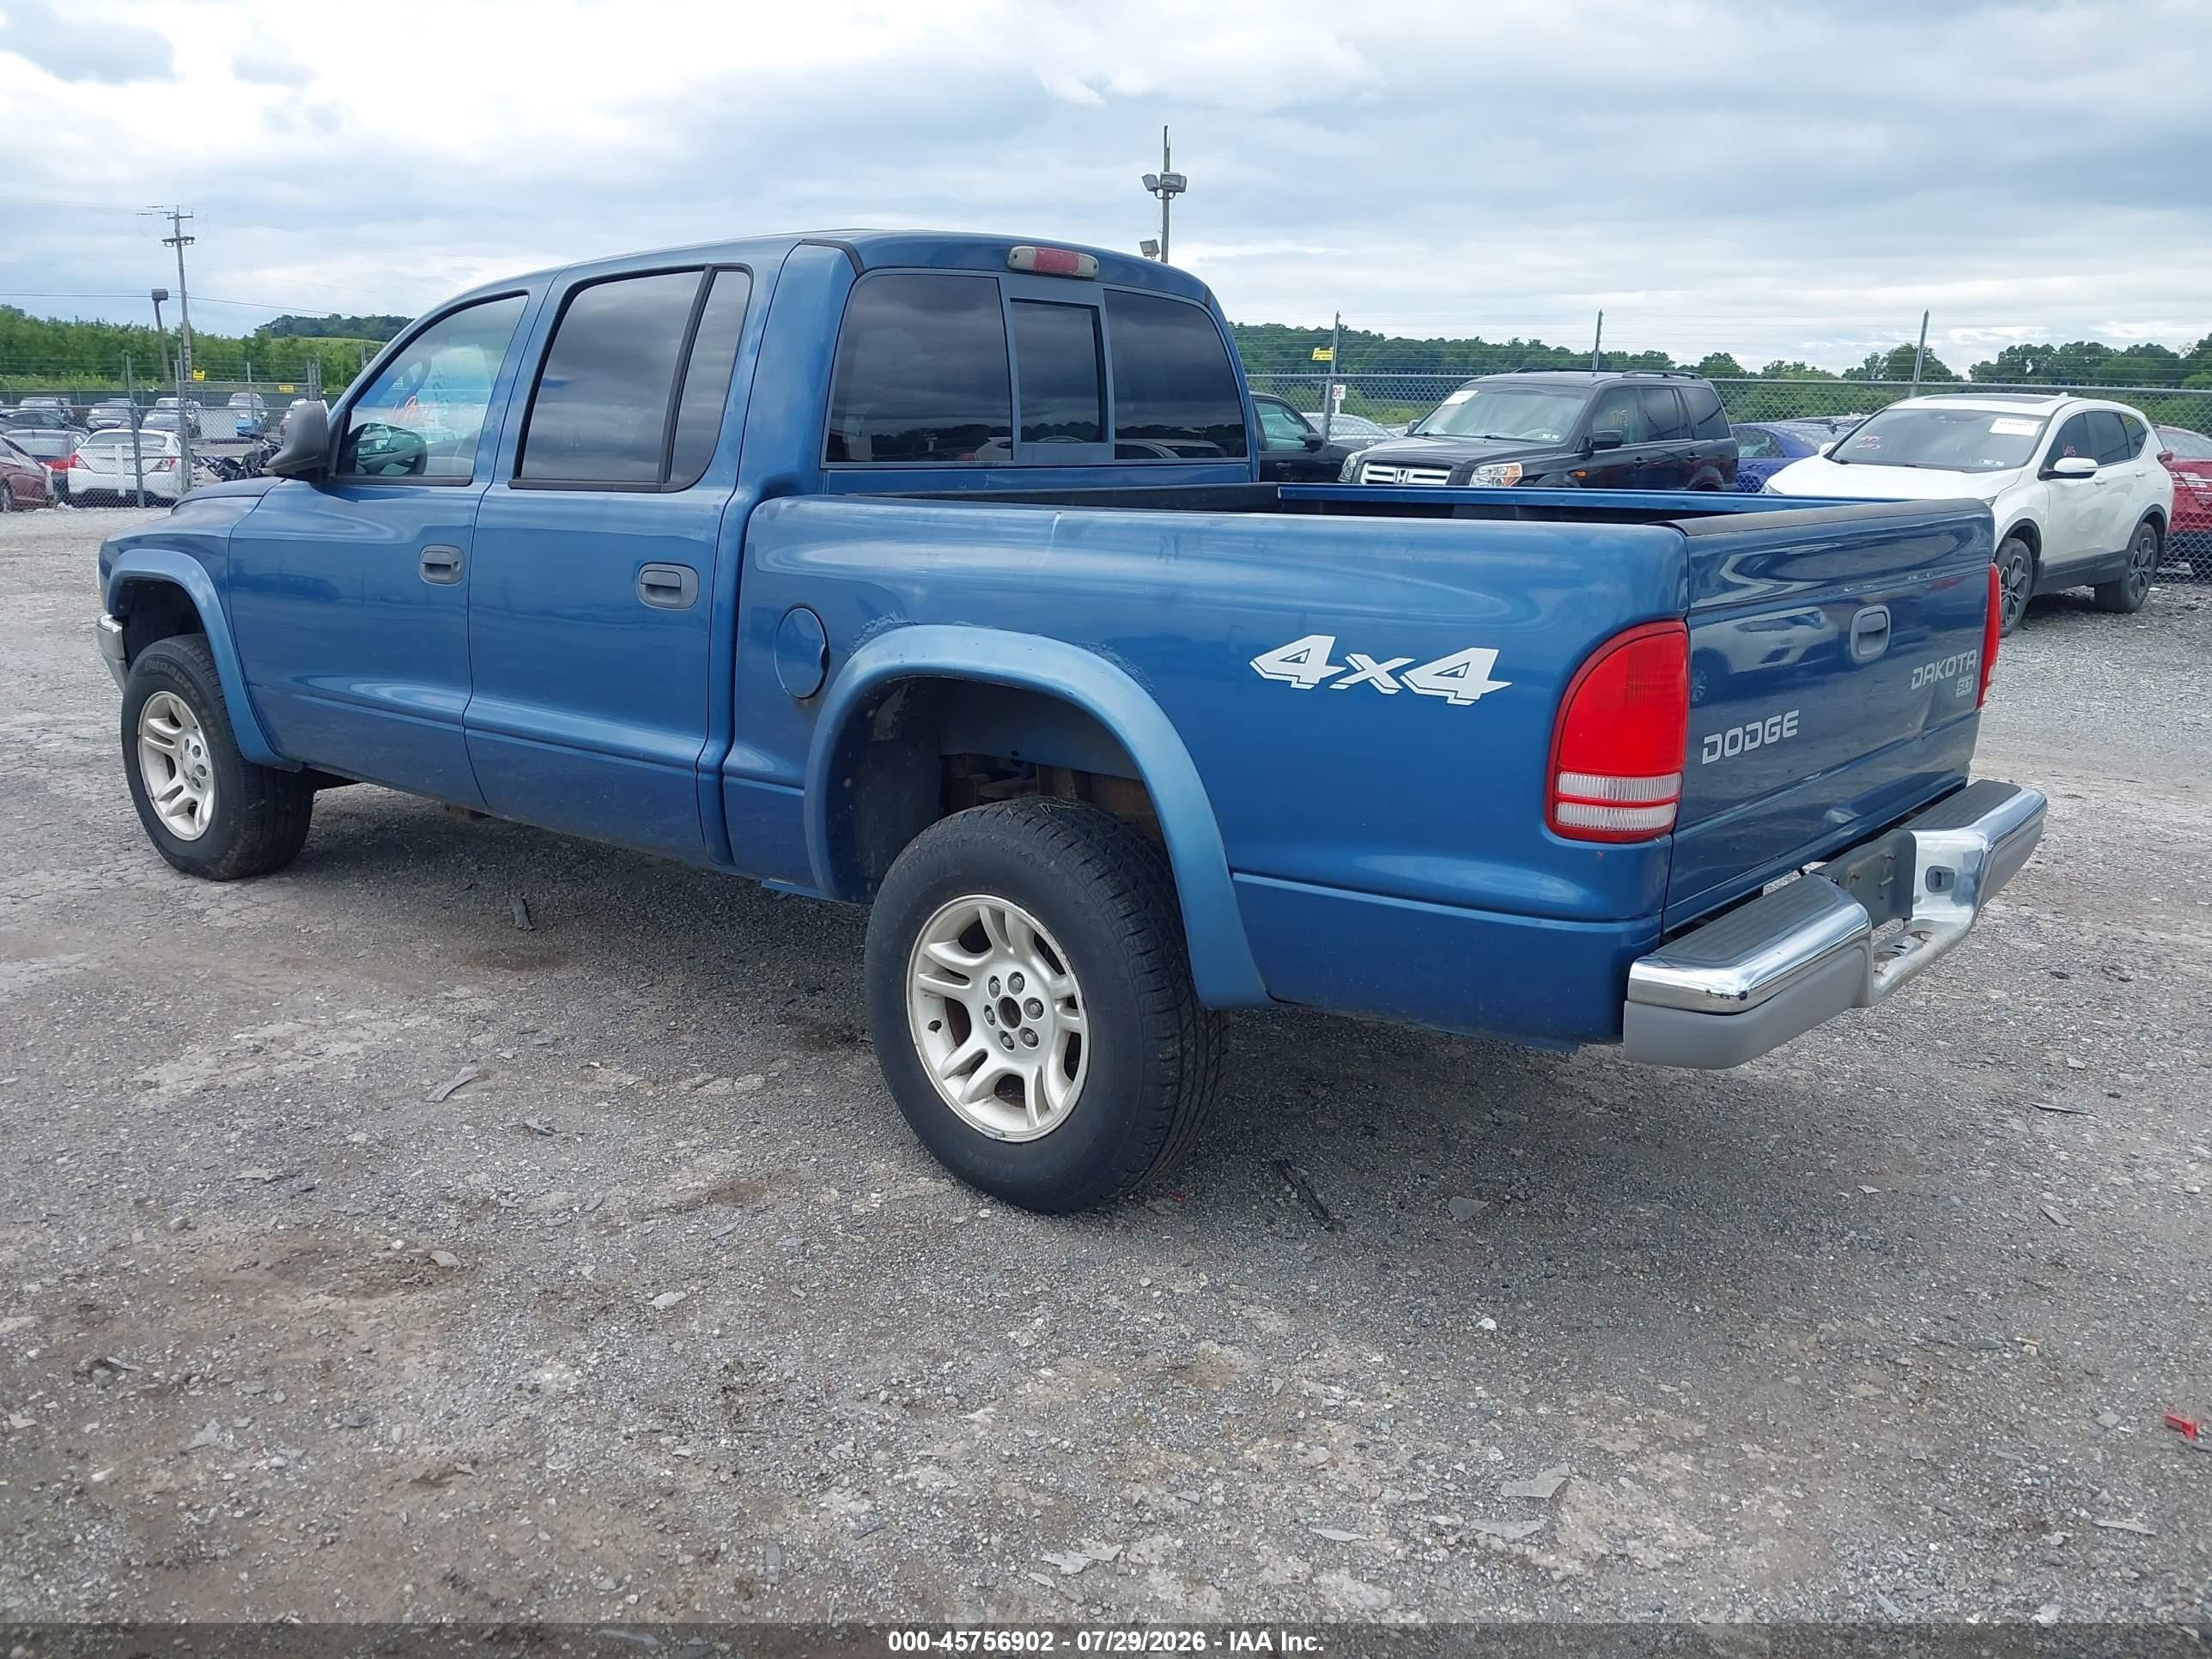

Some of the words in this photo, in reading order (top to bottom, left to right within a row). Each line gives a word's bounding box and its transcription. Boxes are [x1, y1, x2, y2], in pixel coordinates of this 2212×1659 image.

[1911, 649, 1977, 690] DAKOTA
[1957, 676, 1973, 696] SLT
[1702, 709, 1800, 765] DODGE
